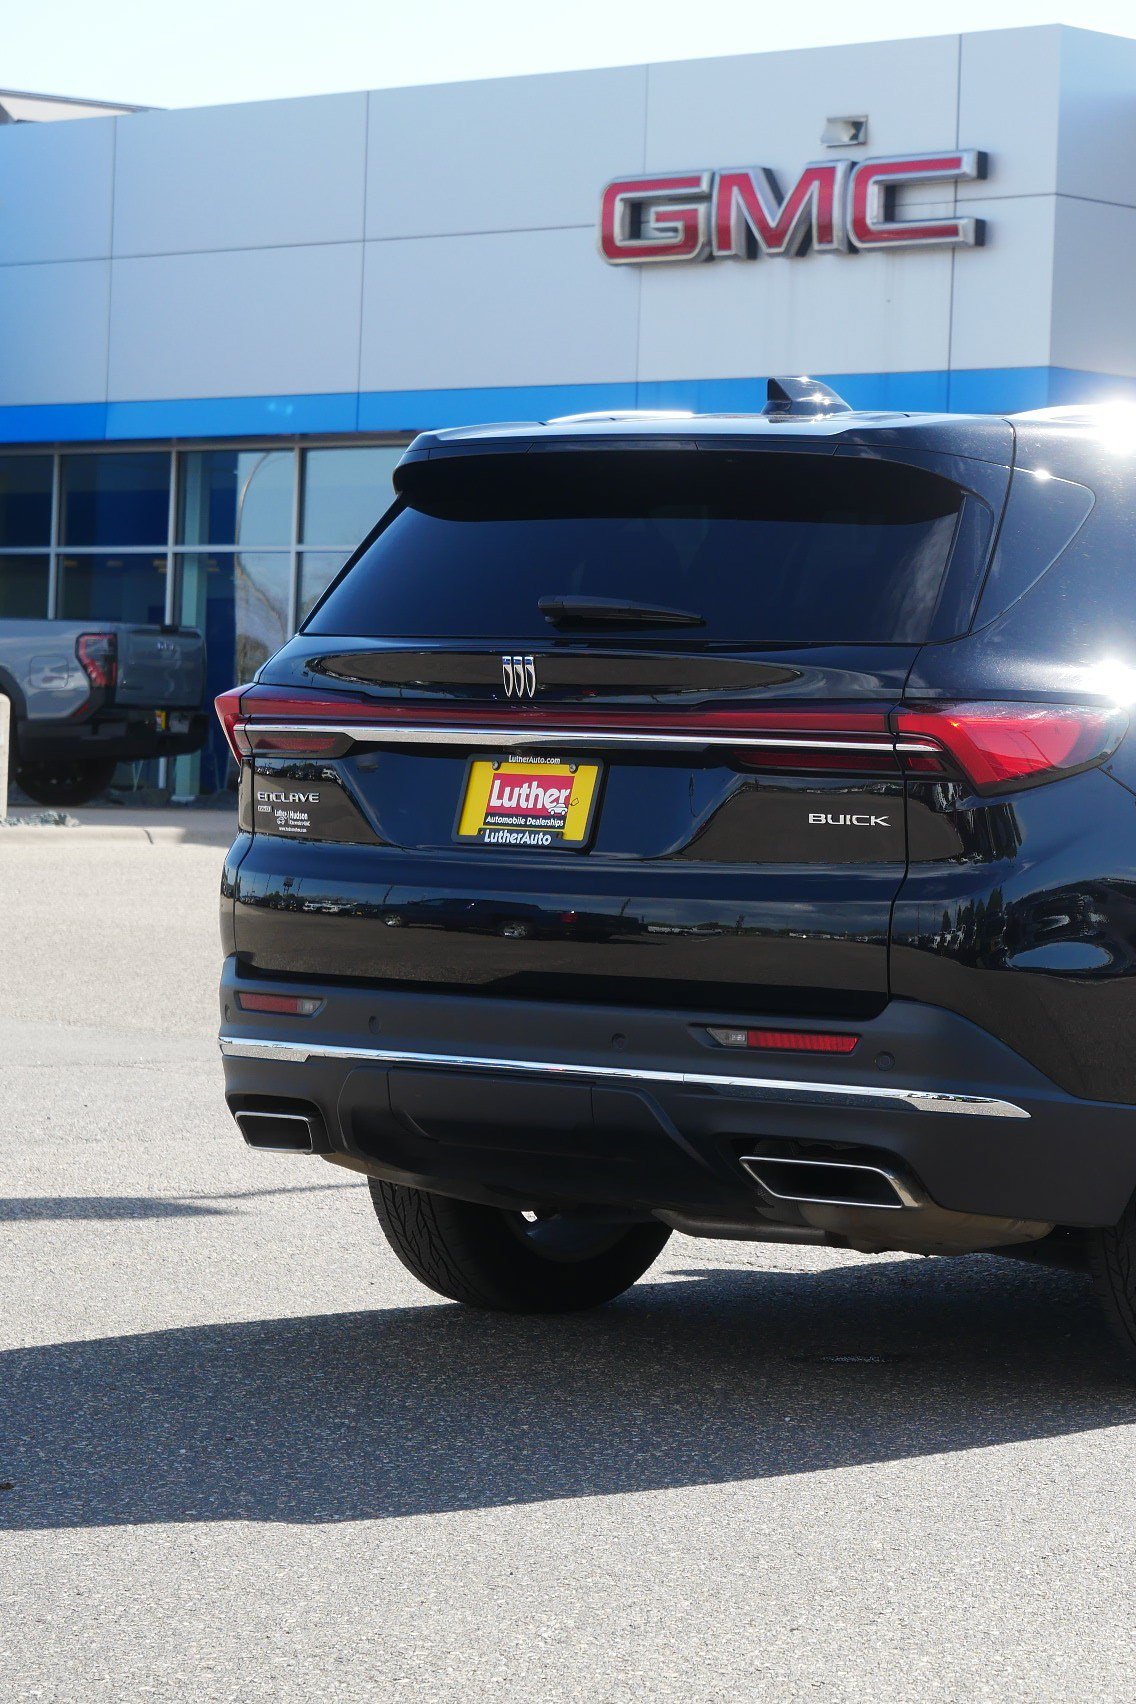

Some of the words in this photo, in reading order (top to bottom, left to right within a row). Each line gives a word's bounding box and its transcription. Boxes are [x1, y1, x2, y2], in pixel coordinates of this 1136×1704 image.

[600, 149, 984, 265] GMC
[508, 754, 561, 765] LutherAuto.com
[257, 791, 320, 803] ENCLAVE
[489, 779, 571, 809] Luther
[289, 810, 308, 820] Hudson
[485, 815, 526, 825] Automobile
[526, 816, 564, 827] Dealerships
[808, 813, 892, 827] BUICK
[484, 829, 552, 846] LutherAuto
